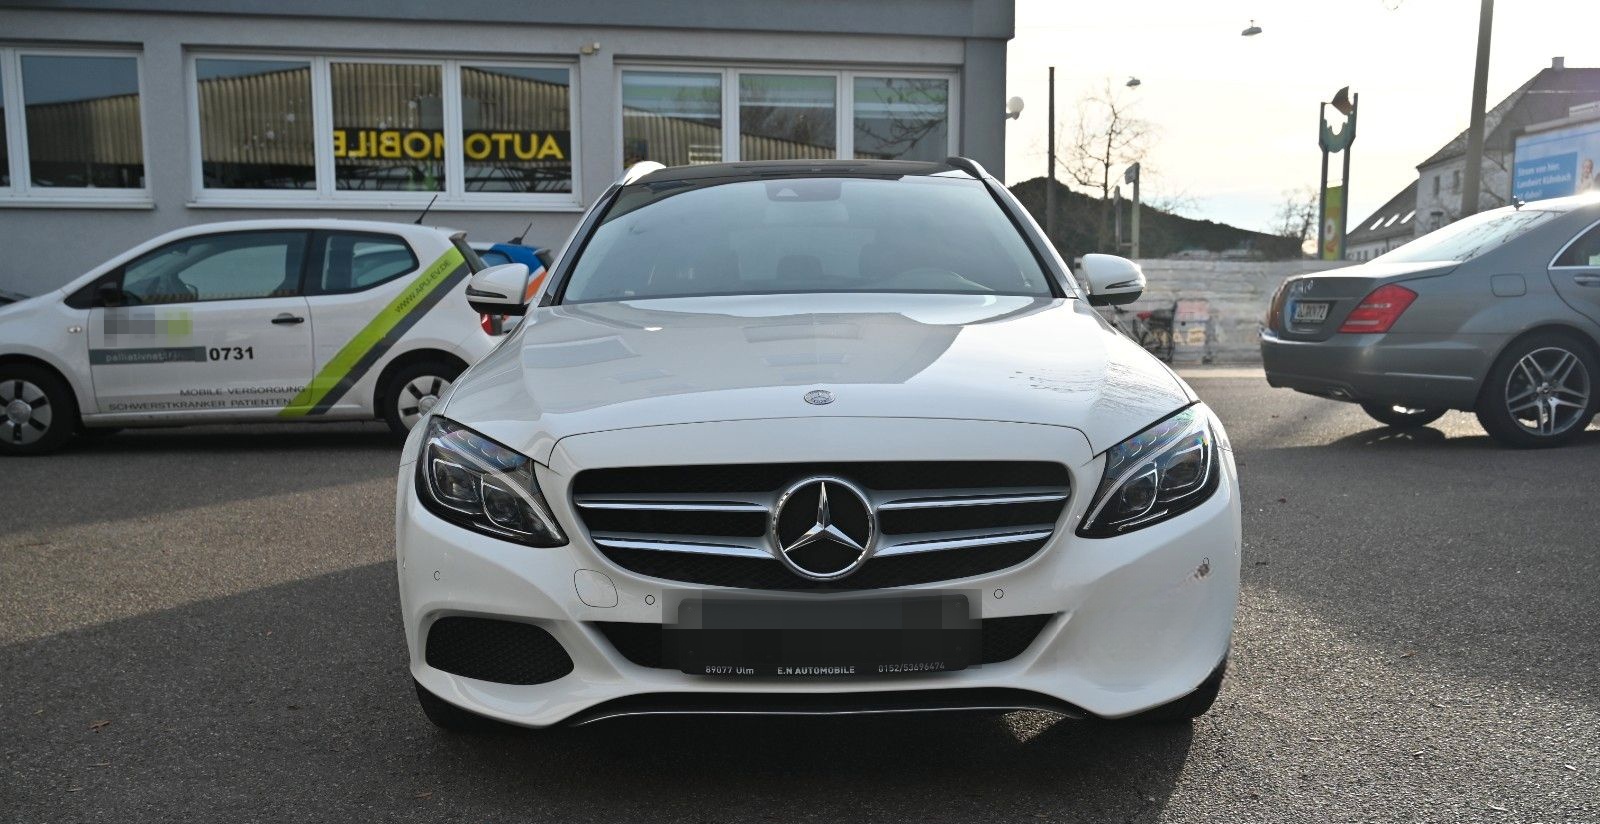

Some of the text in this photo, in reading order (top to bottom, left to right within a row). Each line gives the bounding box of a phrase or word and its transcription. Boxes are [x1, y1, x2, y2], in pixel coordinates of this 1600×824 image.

[209, 346, 254, 361] 0731
[179, 385, 306, 397] MOBILE VERSORGUNG
[109, 397, 292, 411] SCHWERSTKRANKER PATIENTEN
[705, 665, 733, 675] 89077
[736, 666, 754, 675] Ulm
[777, 666, 793, 675] E.N
[794, 665, 856, 675] AUTOMOBILE
